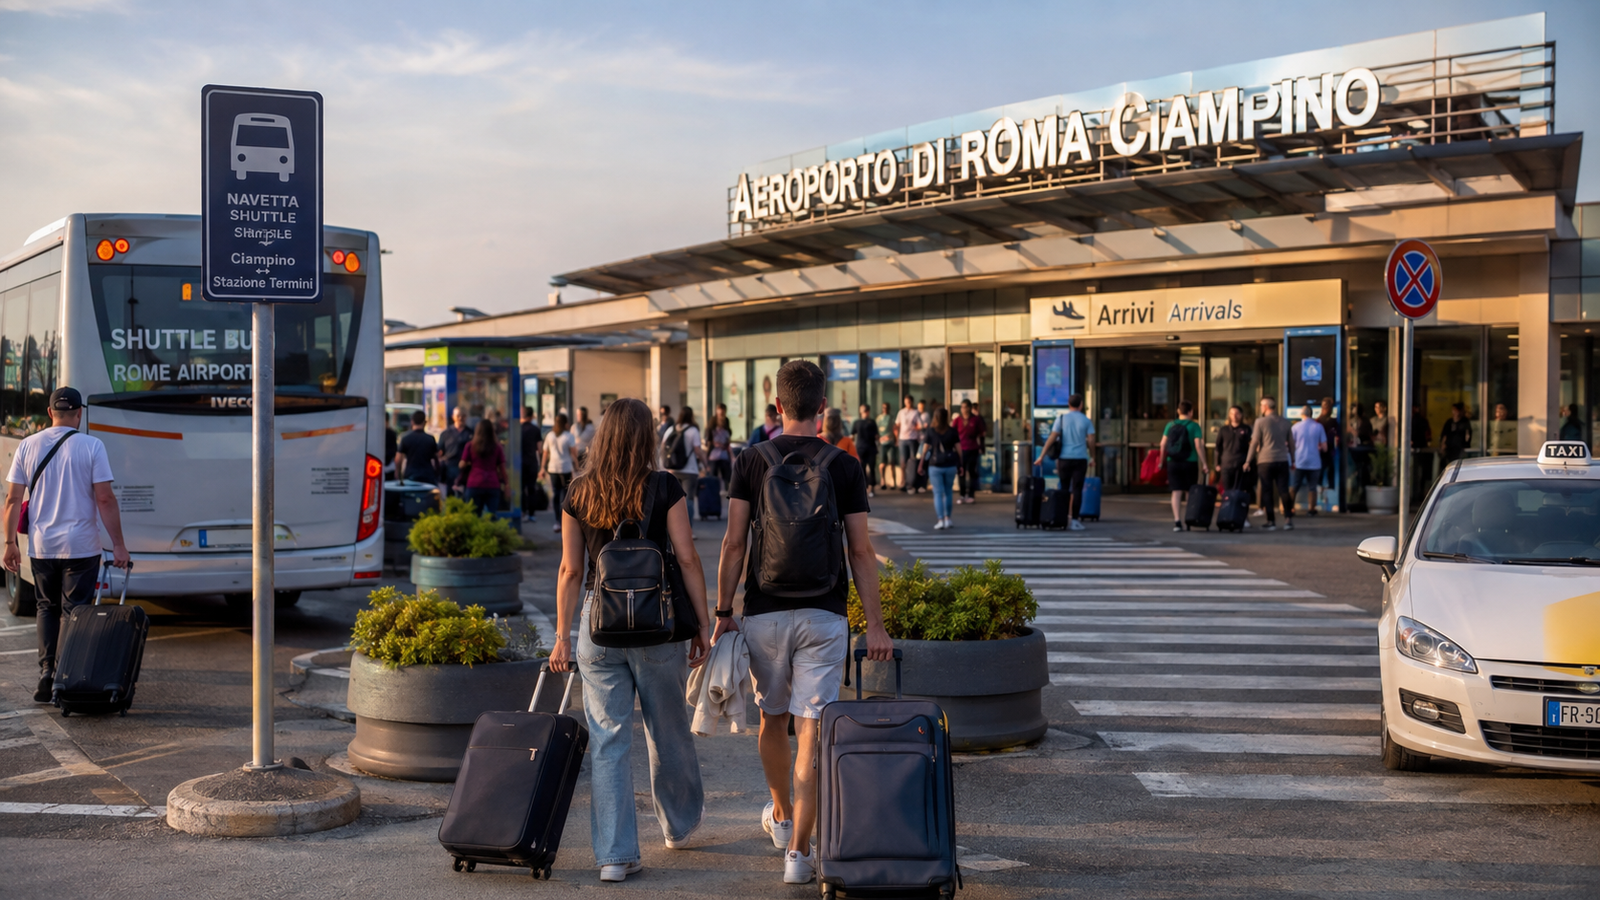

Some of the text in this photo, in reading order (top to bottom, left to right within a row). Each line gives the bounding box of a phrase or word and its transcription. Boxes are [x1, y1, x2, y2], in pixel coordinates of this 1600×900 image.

[732, 67, 1381, 223] AEROPORTO DI ROMA CIAMPINO
[227, 193, 299, 208] NAVETTA
[230, 209, 297, 223] SHUTTLE
[231, 252, 296, 268] Ciampino
[213, 276, 313, 290] Stazione Termini
[1097, 299, 1243, 325] Arrivi Arrivals
[111, 328, 217, 350] SHUTTLE
[113, 364, 171, 382] ROME
[1548, 446, 1583, 457] TAXI
